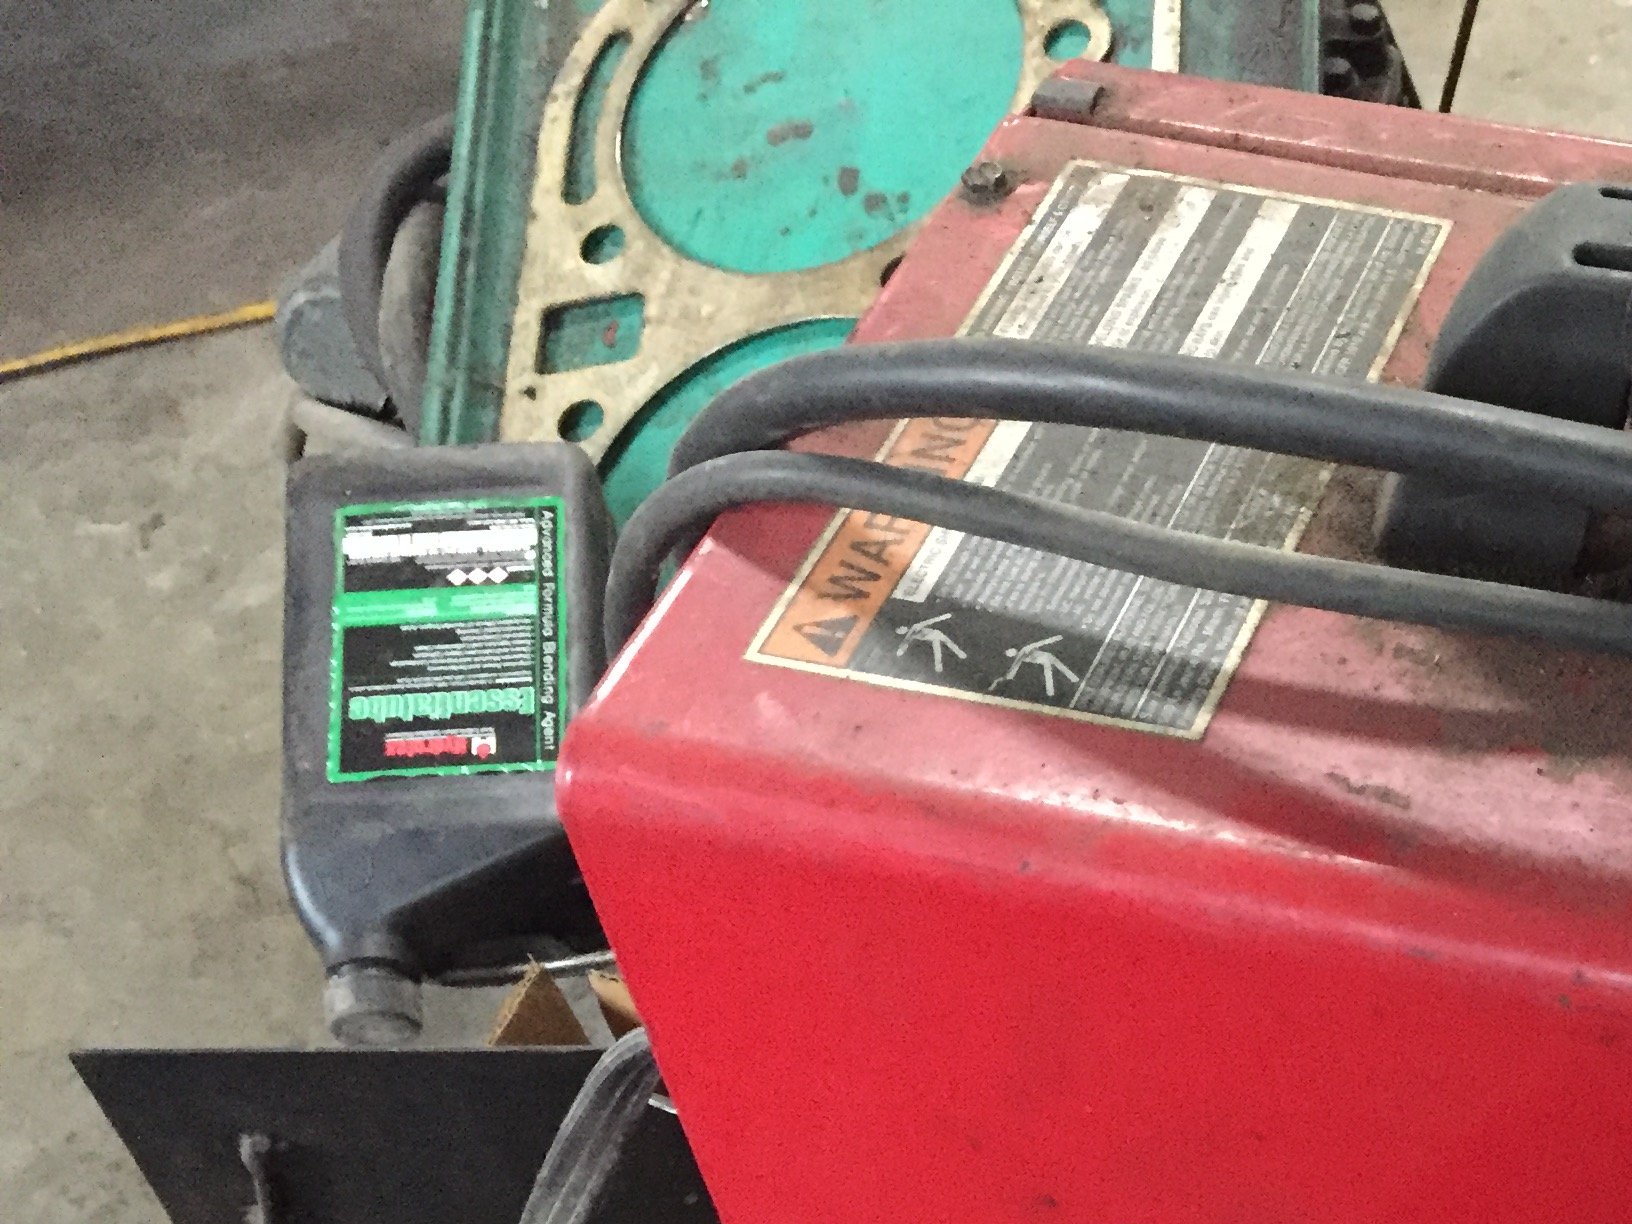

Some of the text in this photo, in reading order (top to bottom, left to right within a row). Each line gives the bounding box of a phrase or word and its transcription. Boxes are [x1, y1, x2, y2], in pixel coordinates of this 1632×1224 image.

[817, 416, 982, 602] WARNG
[540, 641, 556, 704] Blending
[540, 711, 556, 750] Agent
